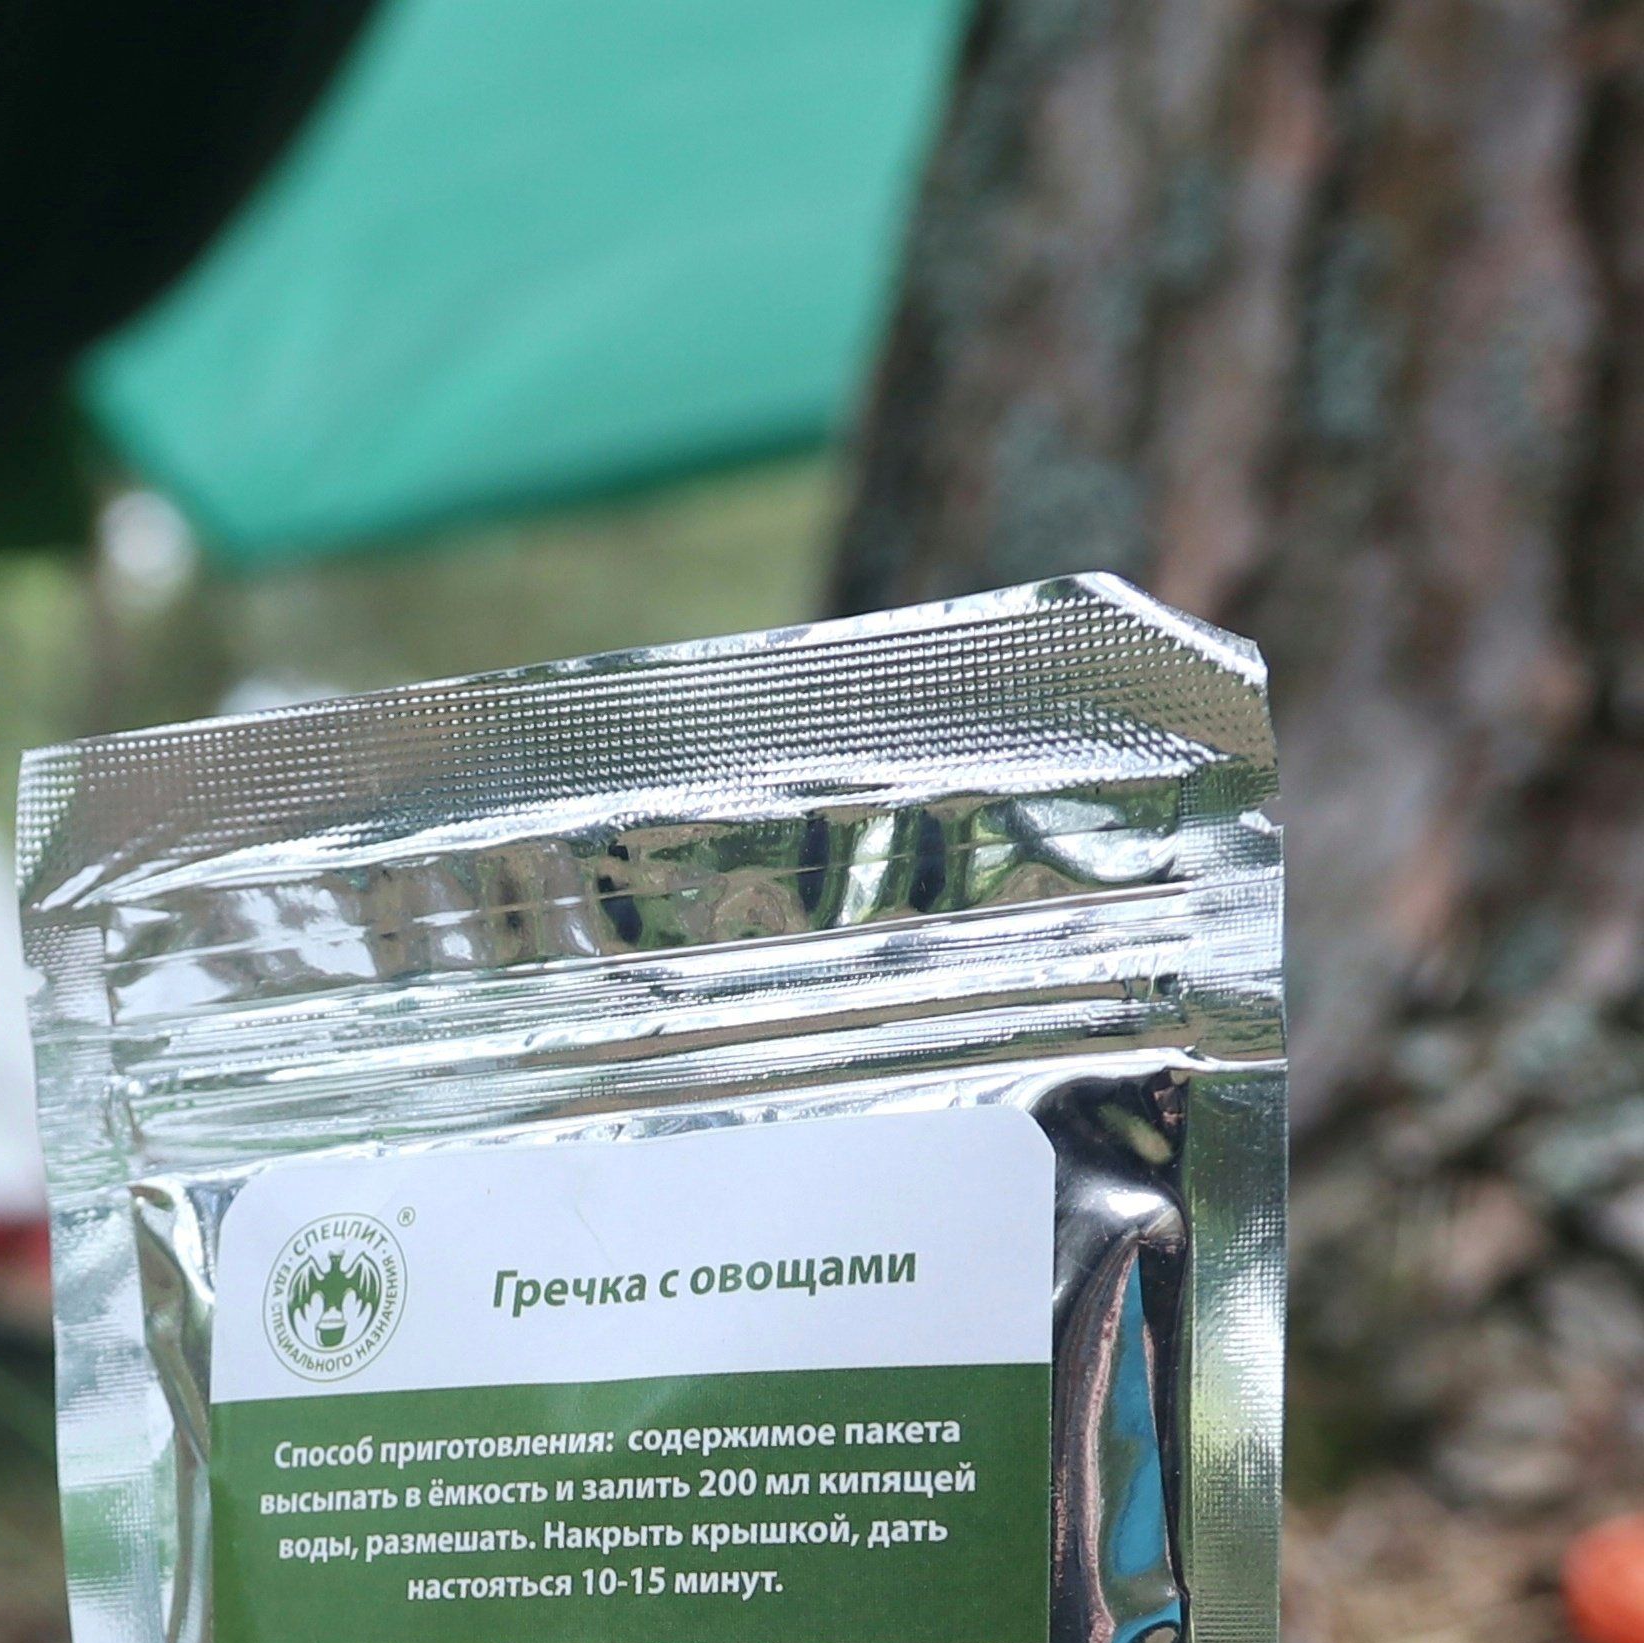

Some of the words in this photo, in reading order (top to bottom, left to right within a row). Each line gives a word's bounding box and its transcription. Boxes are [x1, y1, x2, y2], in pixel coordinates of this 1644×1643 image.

[293, 1221, 388, 1256] СПЕЦПИТ
[273, 1263, 291, 1297] ЕДА
[493, 1270, 646, 1318] Гречка
[659, 1270, 679, 1298] с
[690, 1252, 916, 1296] овощами
[356, 1255, 398, 1360] НАЗНАЧЕНИЯ
[271, 1302, 353, 1372] СПЕЦИАЛЬНОГО
[275, 1436, 373, 1468] Способ
[380, 1431, 614, 1469] приготовления:
[628, 1424, 836, 1456] содержимое
[845, 1421, 960, 1444] пакета
[261, 1489, 398, 1514] высыпать
[406, 1487, 421, 1507] в
[428, 1479, 548, 1506] ёмкость
[556, 1480, 573, 1501] и
[582, 1477, 690, 1500] залить
[699, 1468, 757, 1497] 200
[766, 1474, 809, 1495] мл
[820, 1462, 975, 1498] кипящей
[279, 1536, 358, 1563] воды,
[366, 1530, 536, 1562] размешать.
[544, 1521, 683, 1554] Накрыть
[692, 1513, 859, 1552] крышкой,
[867, 1520, 948, 1548] дать
[408, 1575, 571, 1600] настояться
[582, 1567, 665, 1595] 10-15
[675, 1571, 783, 1601] минут.
